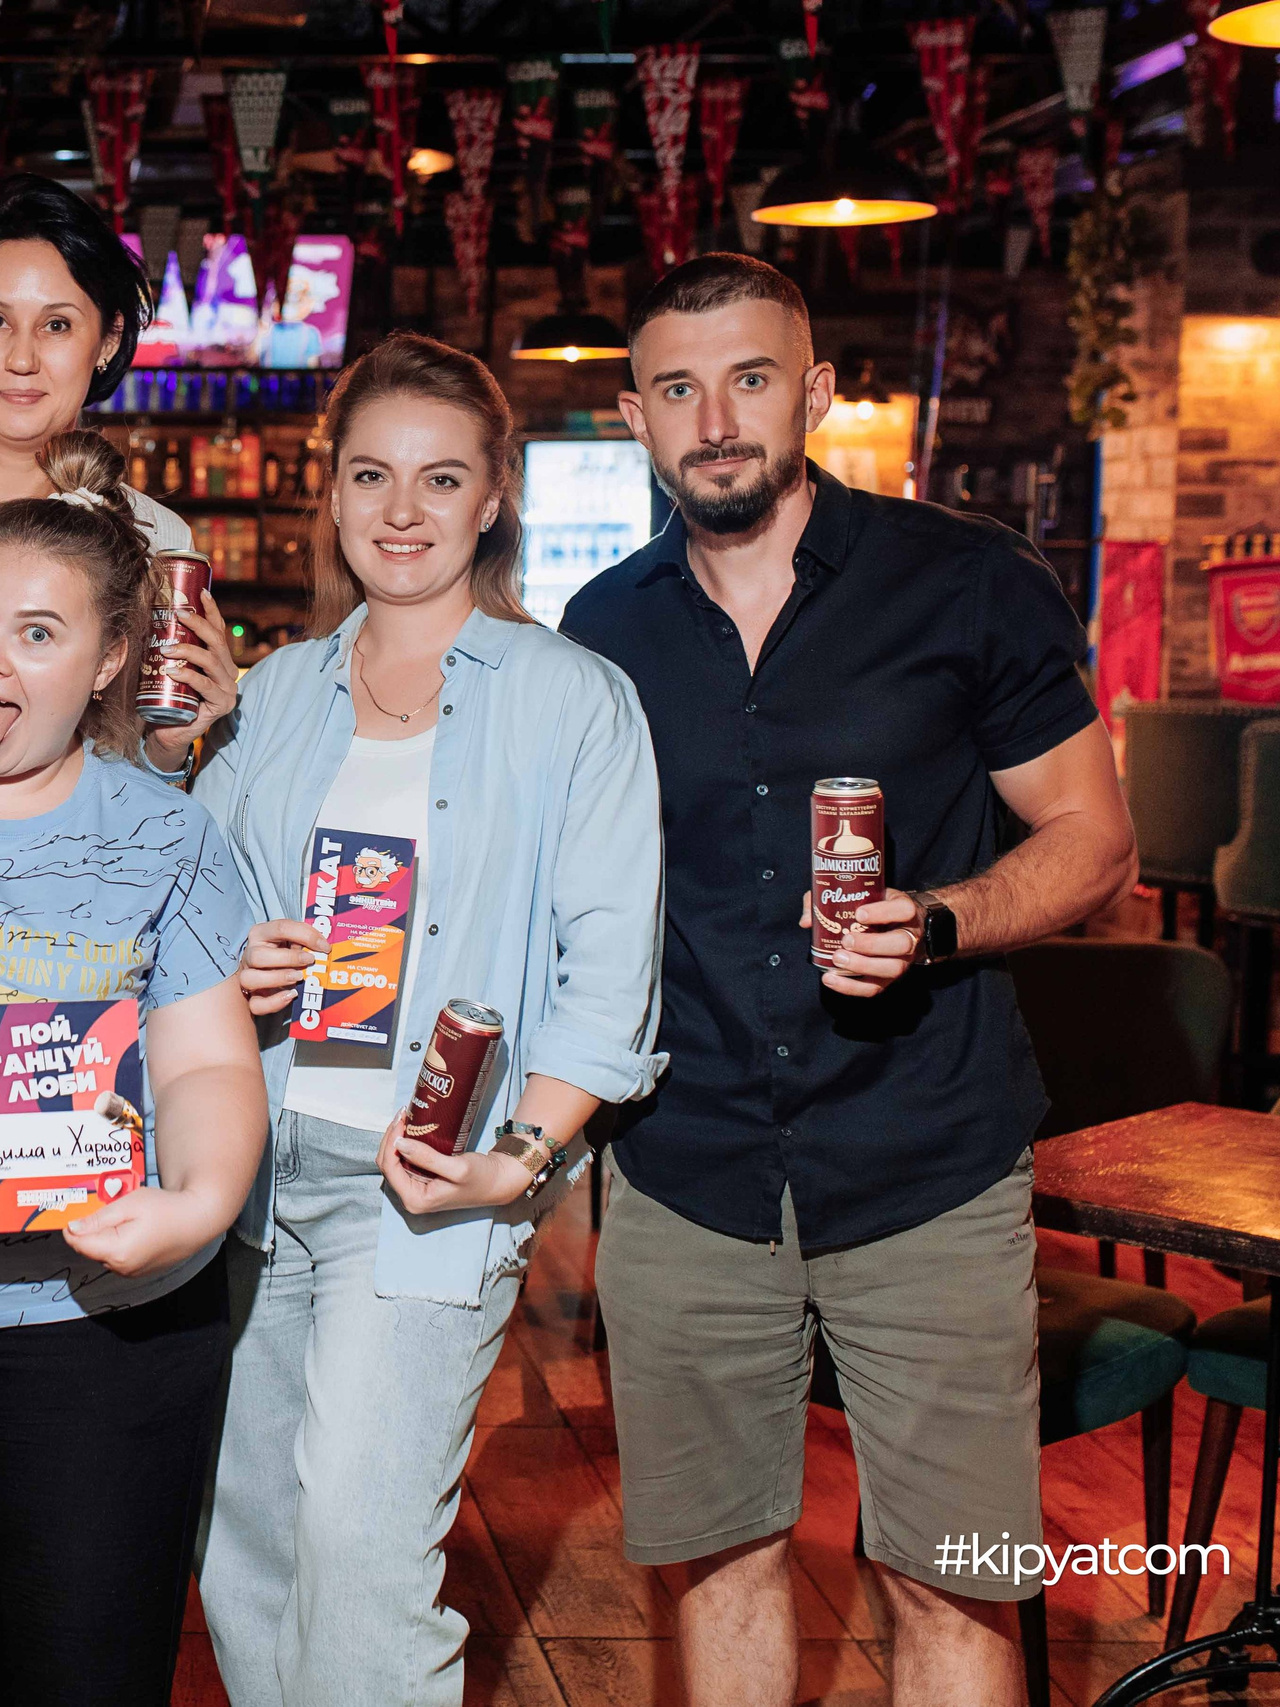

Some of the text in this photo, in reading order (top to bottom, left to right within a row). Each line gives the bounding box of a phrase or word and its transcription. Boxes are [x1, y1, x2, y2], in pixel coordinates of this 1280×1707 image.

[814, 854, 880, 872] ШЫМКЕНТСКОЕ
[821, 887, 870, 905] Pilsner
[835, 911, 856, 920] 4,0%
[329, 970, 349, 985] 13
[350, 972, 388, 989] 000
[11, 1014, 78, 1047] ПОЙ,
[8, 1070, 97, 1103] ЛЮБИ
[52, 1146, 61, 1156] и
[67, 1124, 144, 1164] Харибда
